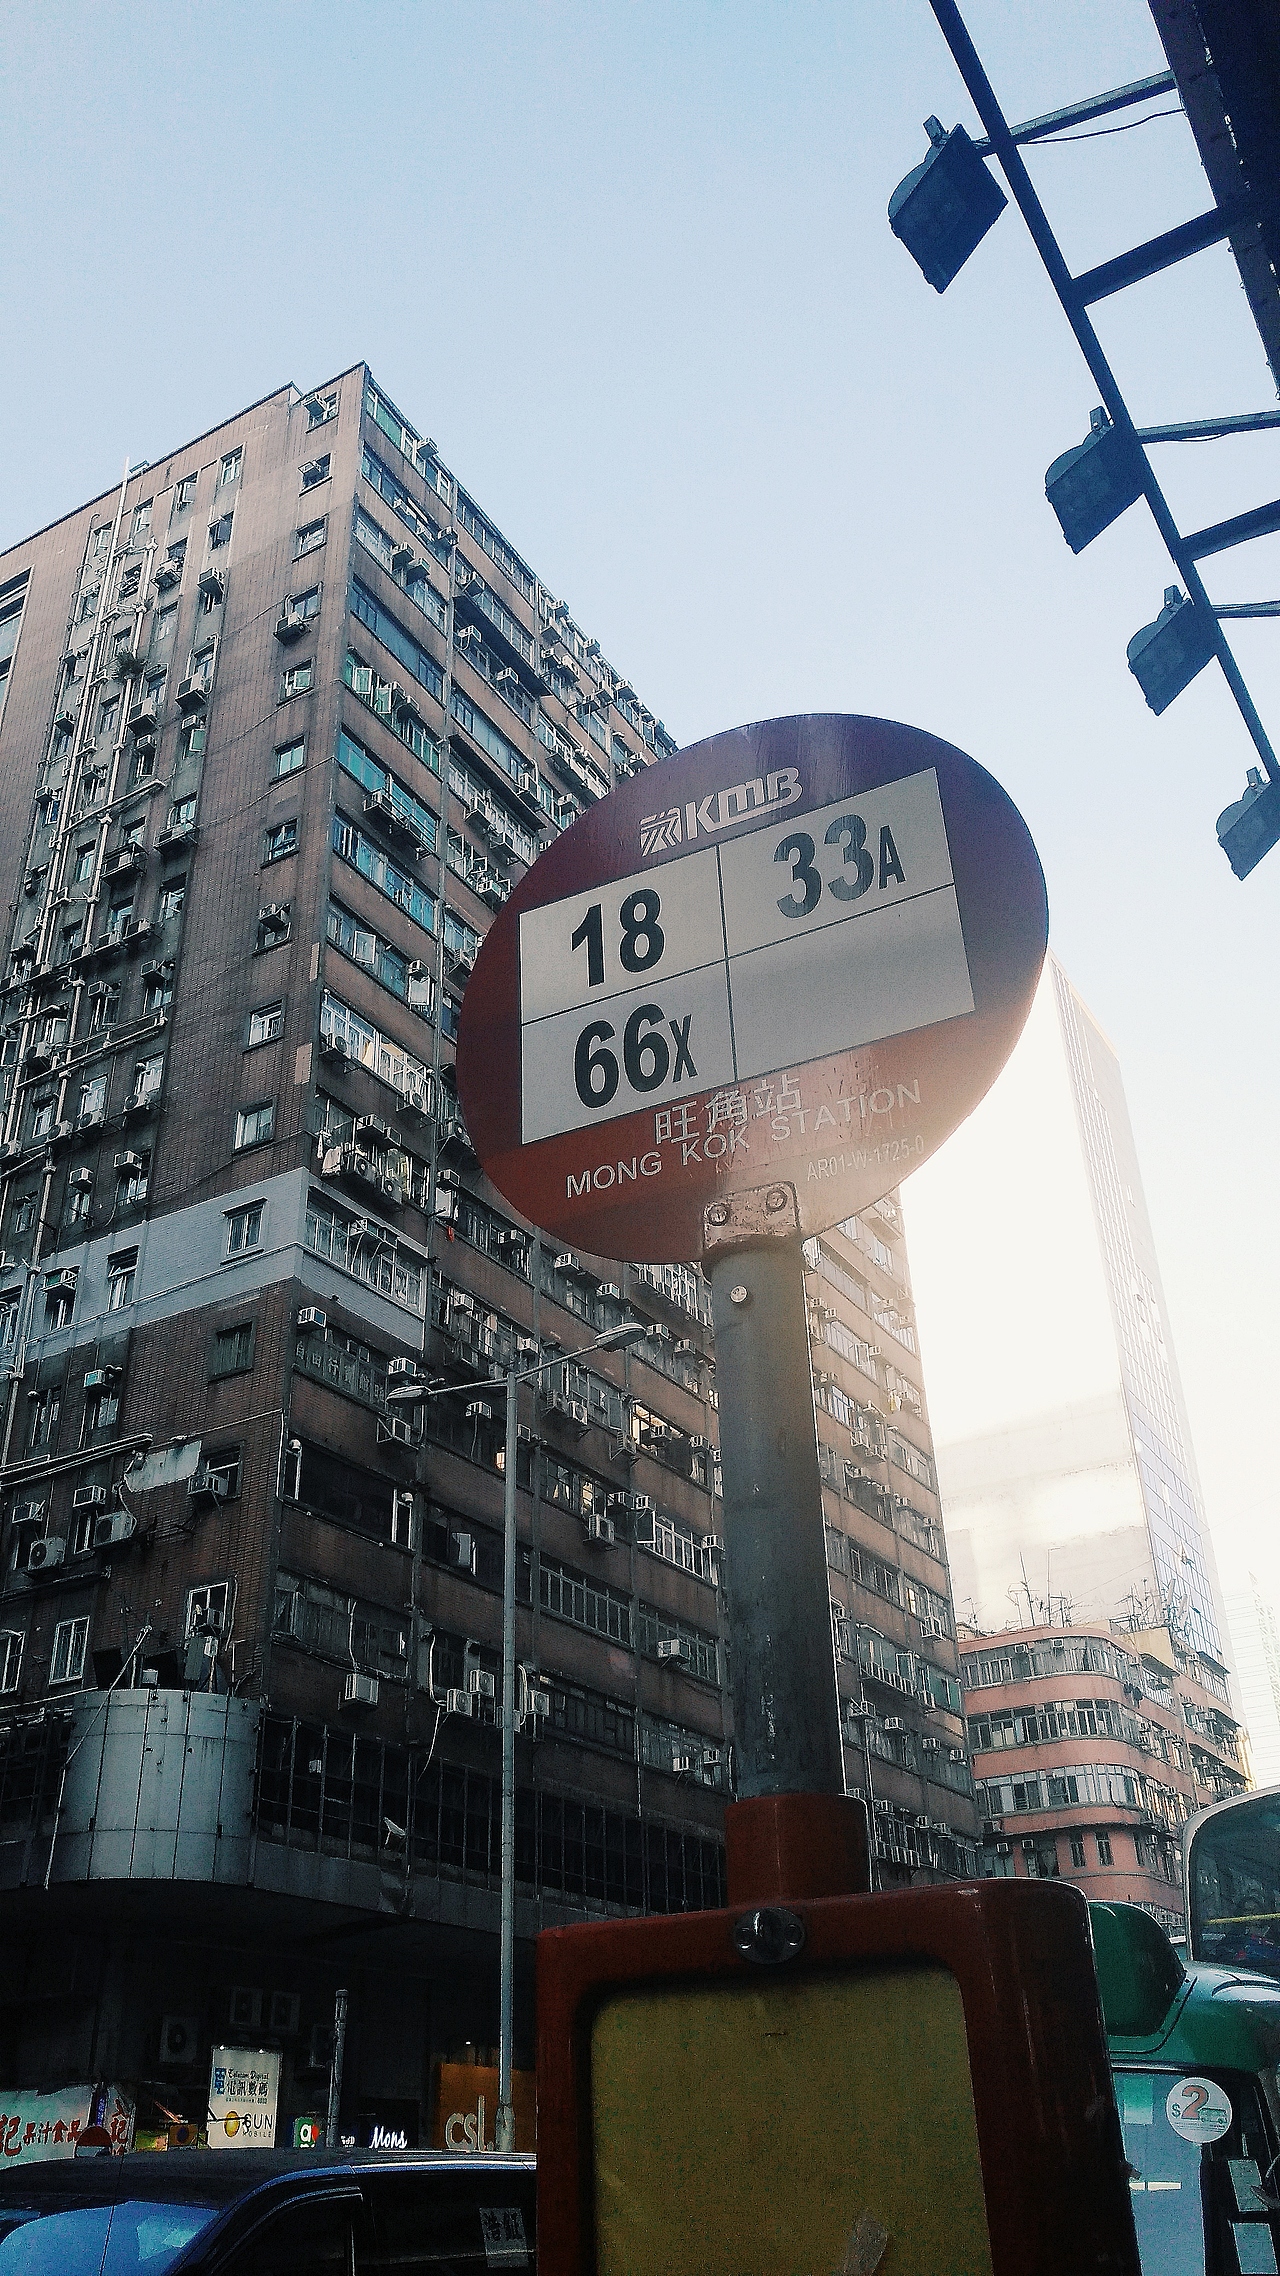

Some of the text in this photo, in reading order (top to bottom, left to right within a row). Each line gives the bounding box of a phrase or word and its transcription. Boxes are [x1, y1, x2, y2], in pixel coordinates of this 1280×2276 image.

[686, 767, 803, 840] KMB
[773, 813, 906, 919] 33A
[570, 888, 665, 987] 18
[573, 1002, 698, 1109] 66X
[565, 1078, 922, 1199] MONG KOK STATION
[654, 1073, 803, 1146] 旺角站
[242, 2112, 273, 2130] SUN
